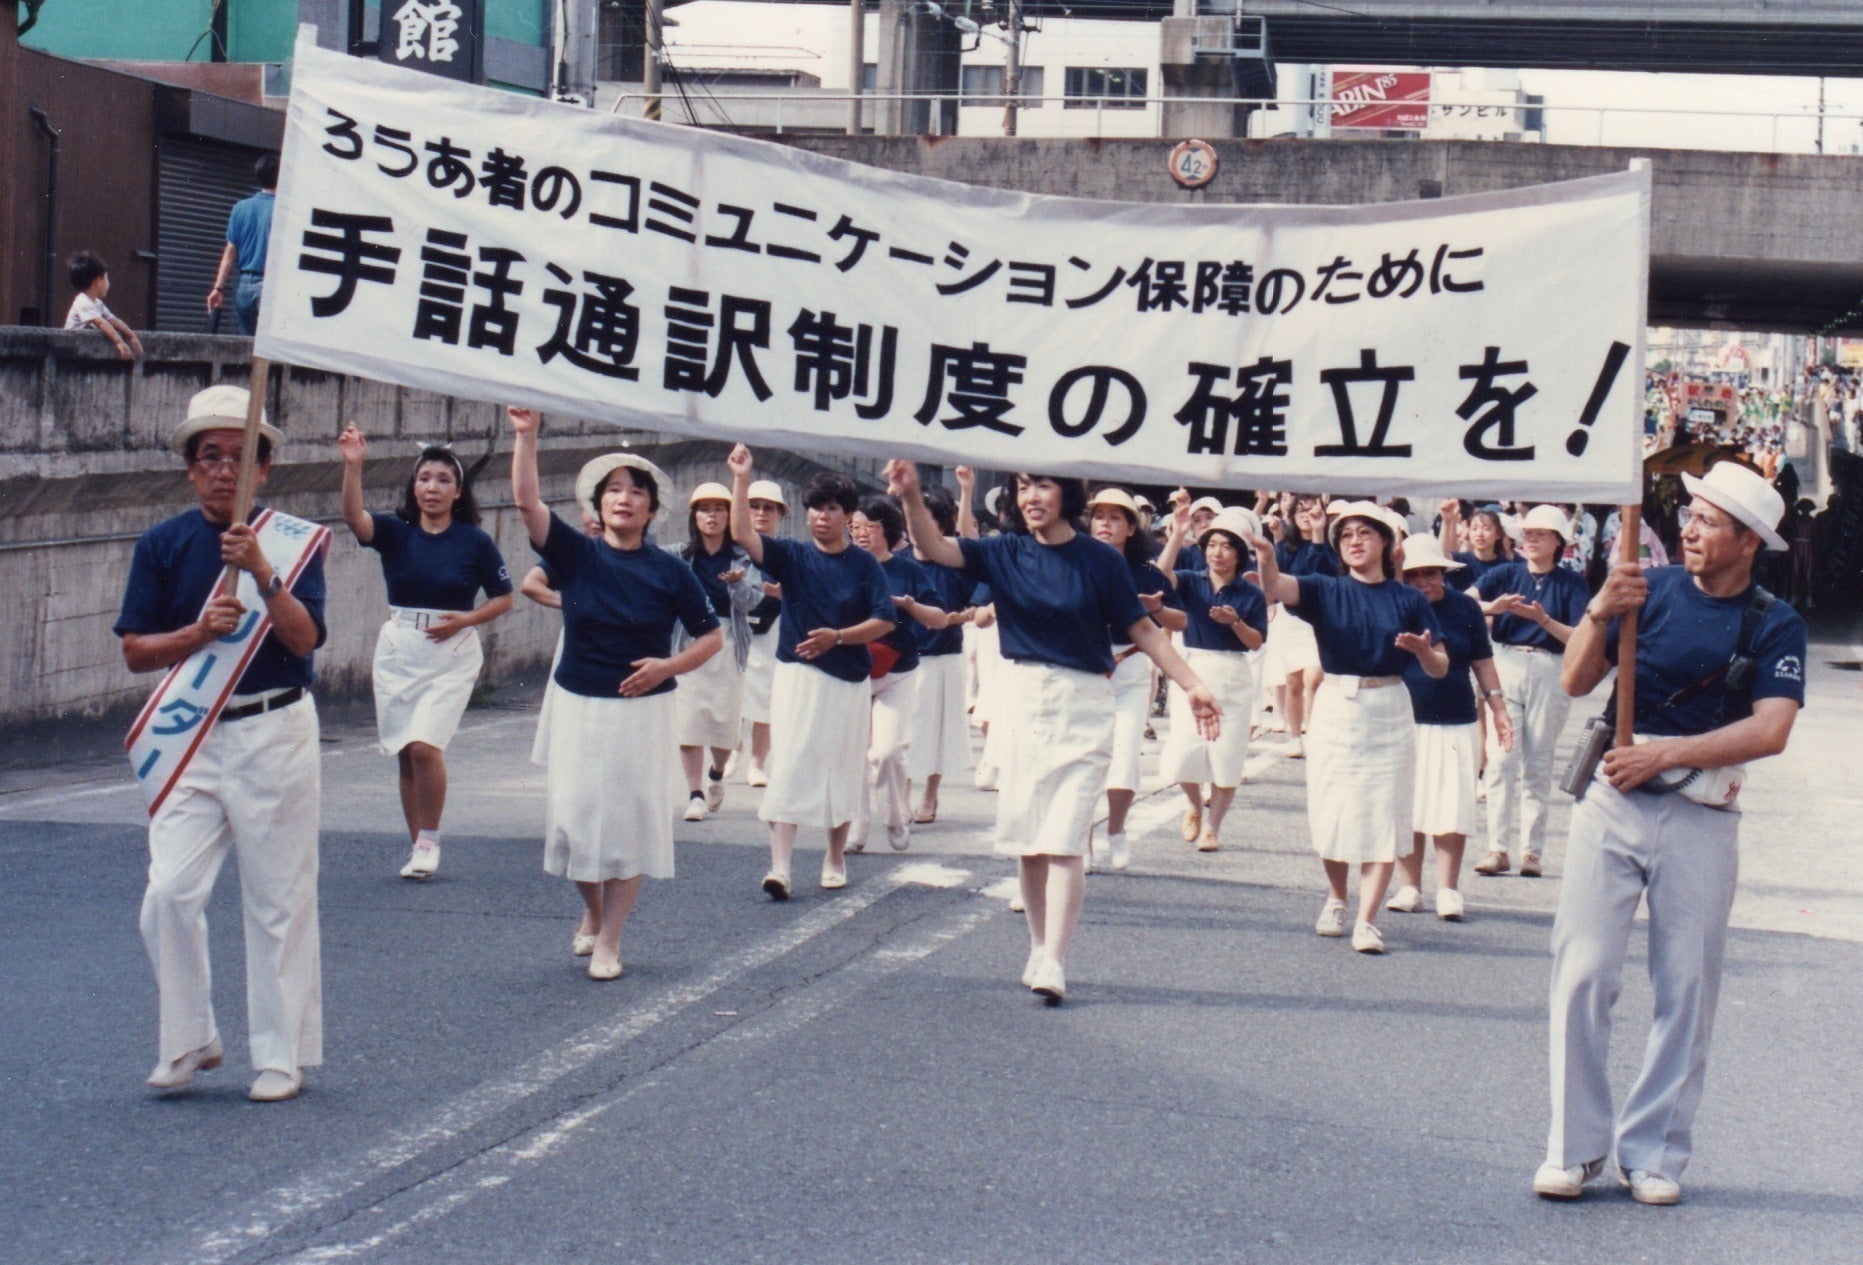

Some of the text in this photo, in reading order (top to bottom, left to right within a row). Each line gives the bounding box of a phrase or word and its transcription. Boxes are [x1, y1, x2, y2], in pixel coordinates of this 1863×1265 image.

[392, 0, 463, 62] 館
[323, 108, 1484, 317] ろうあ者のコミュニケーション保障のために
[299, 208, 1631, 461] 手話通訳制度の確立を!
